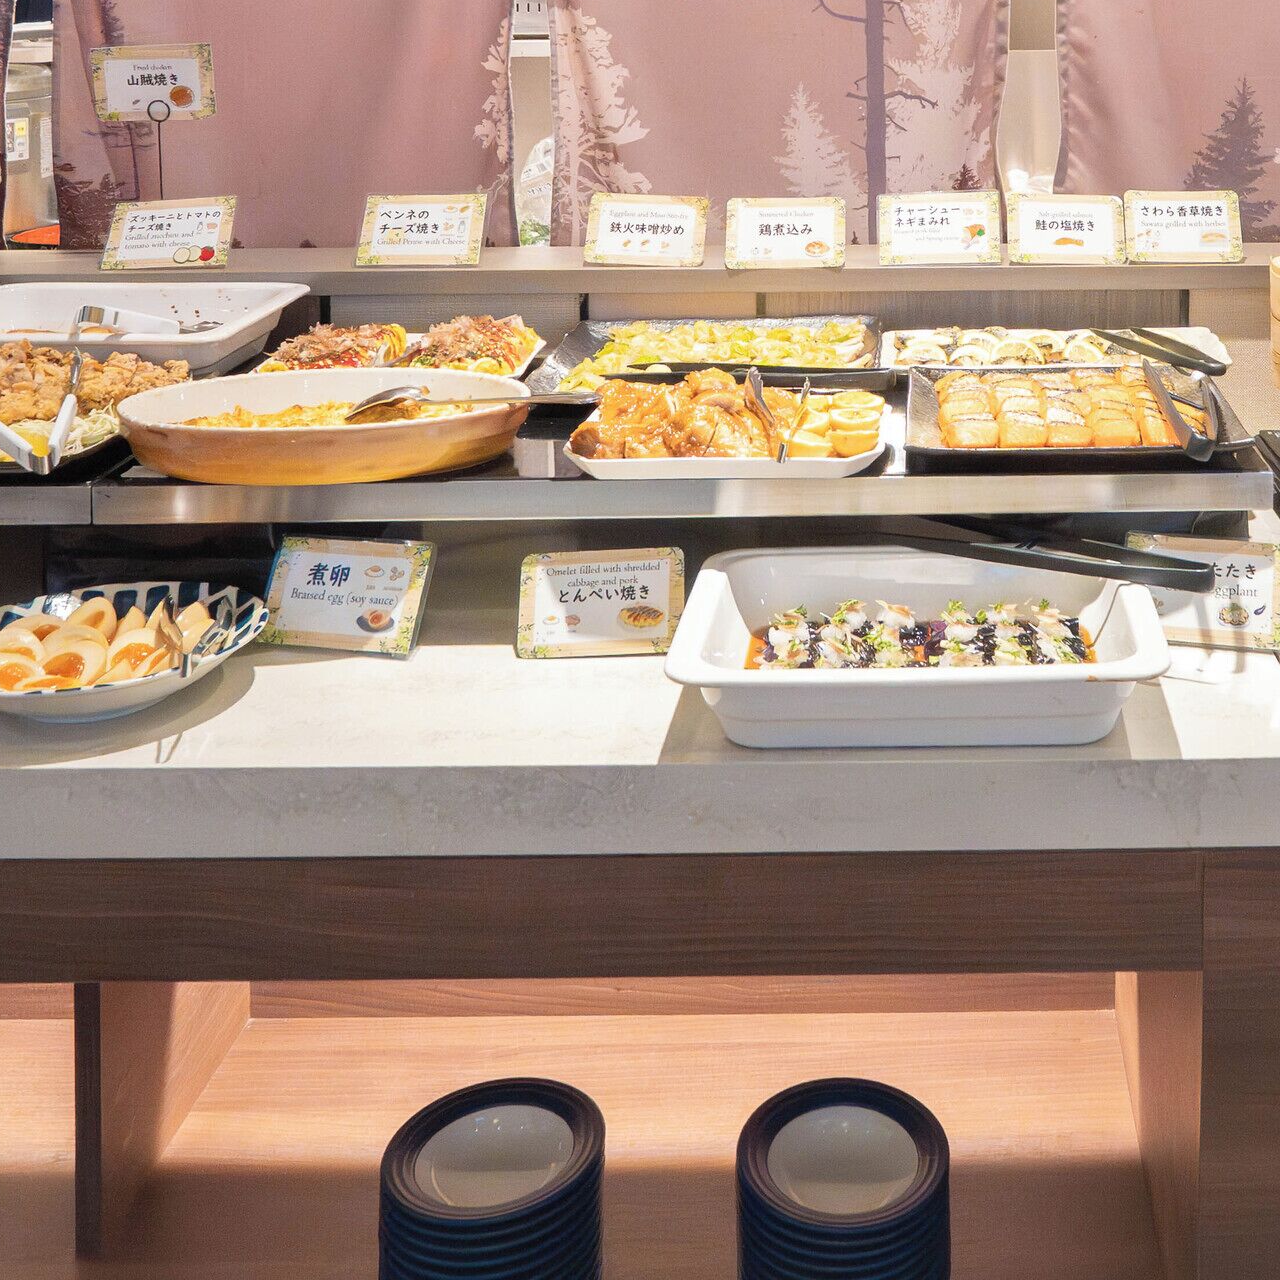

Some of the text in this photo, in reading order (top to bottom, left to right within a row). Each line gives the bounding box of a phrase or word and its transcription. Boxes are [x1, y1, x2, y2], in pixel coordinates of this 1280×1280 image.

[127, 73, 178, 86] 山賊焼き
[130, 210, 221, 223] ズッキーニとトマトの
[380, 209, 429, 221] ペンネの
[895, 206, 960, 216] チャーシュー
[1141, 205, 1223, 217] さわら香草焼き
[128, 223, 172, 232] チーズ焼き
[380, 223, 439, 234] チーズ焼き
[610, 221, 684, 236] 鉄火味噌炒め
[895, 217, 951, 227] ネギまみれ
[1035, 219, 1095, 232] 鮭の塩焼き
[759, 223, 813, 237] 鶏煮込み
[306, 563, 351, 587] 煮卵
[546, 561, 661, 577] Omelet filled with shredded
[567, 575, 639, 588] cabbage and pork
[291, 587, 399, 608] Braised egg (soy sauce)
[559, 585, 650, 603] とんぺい焼き
